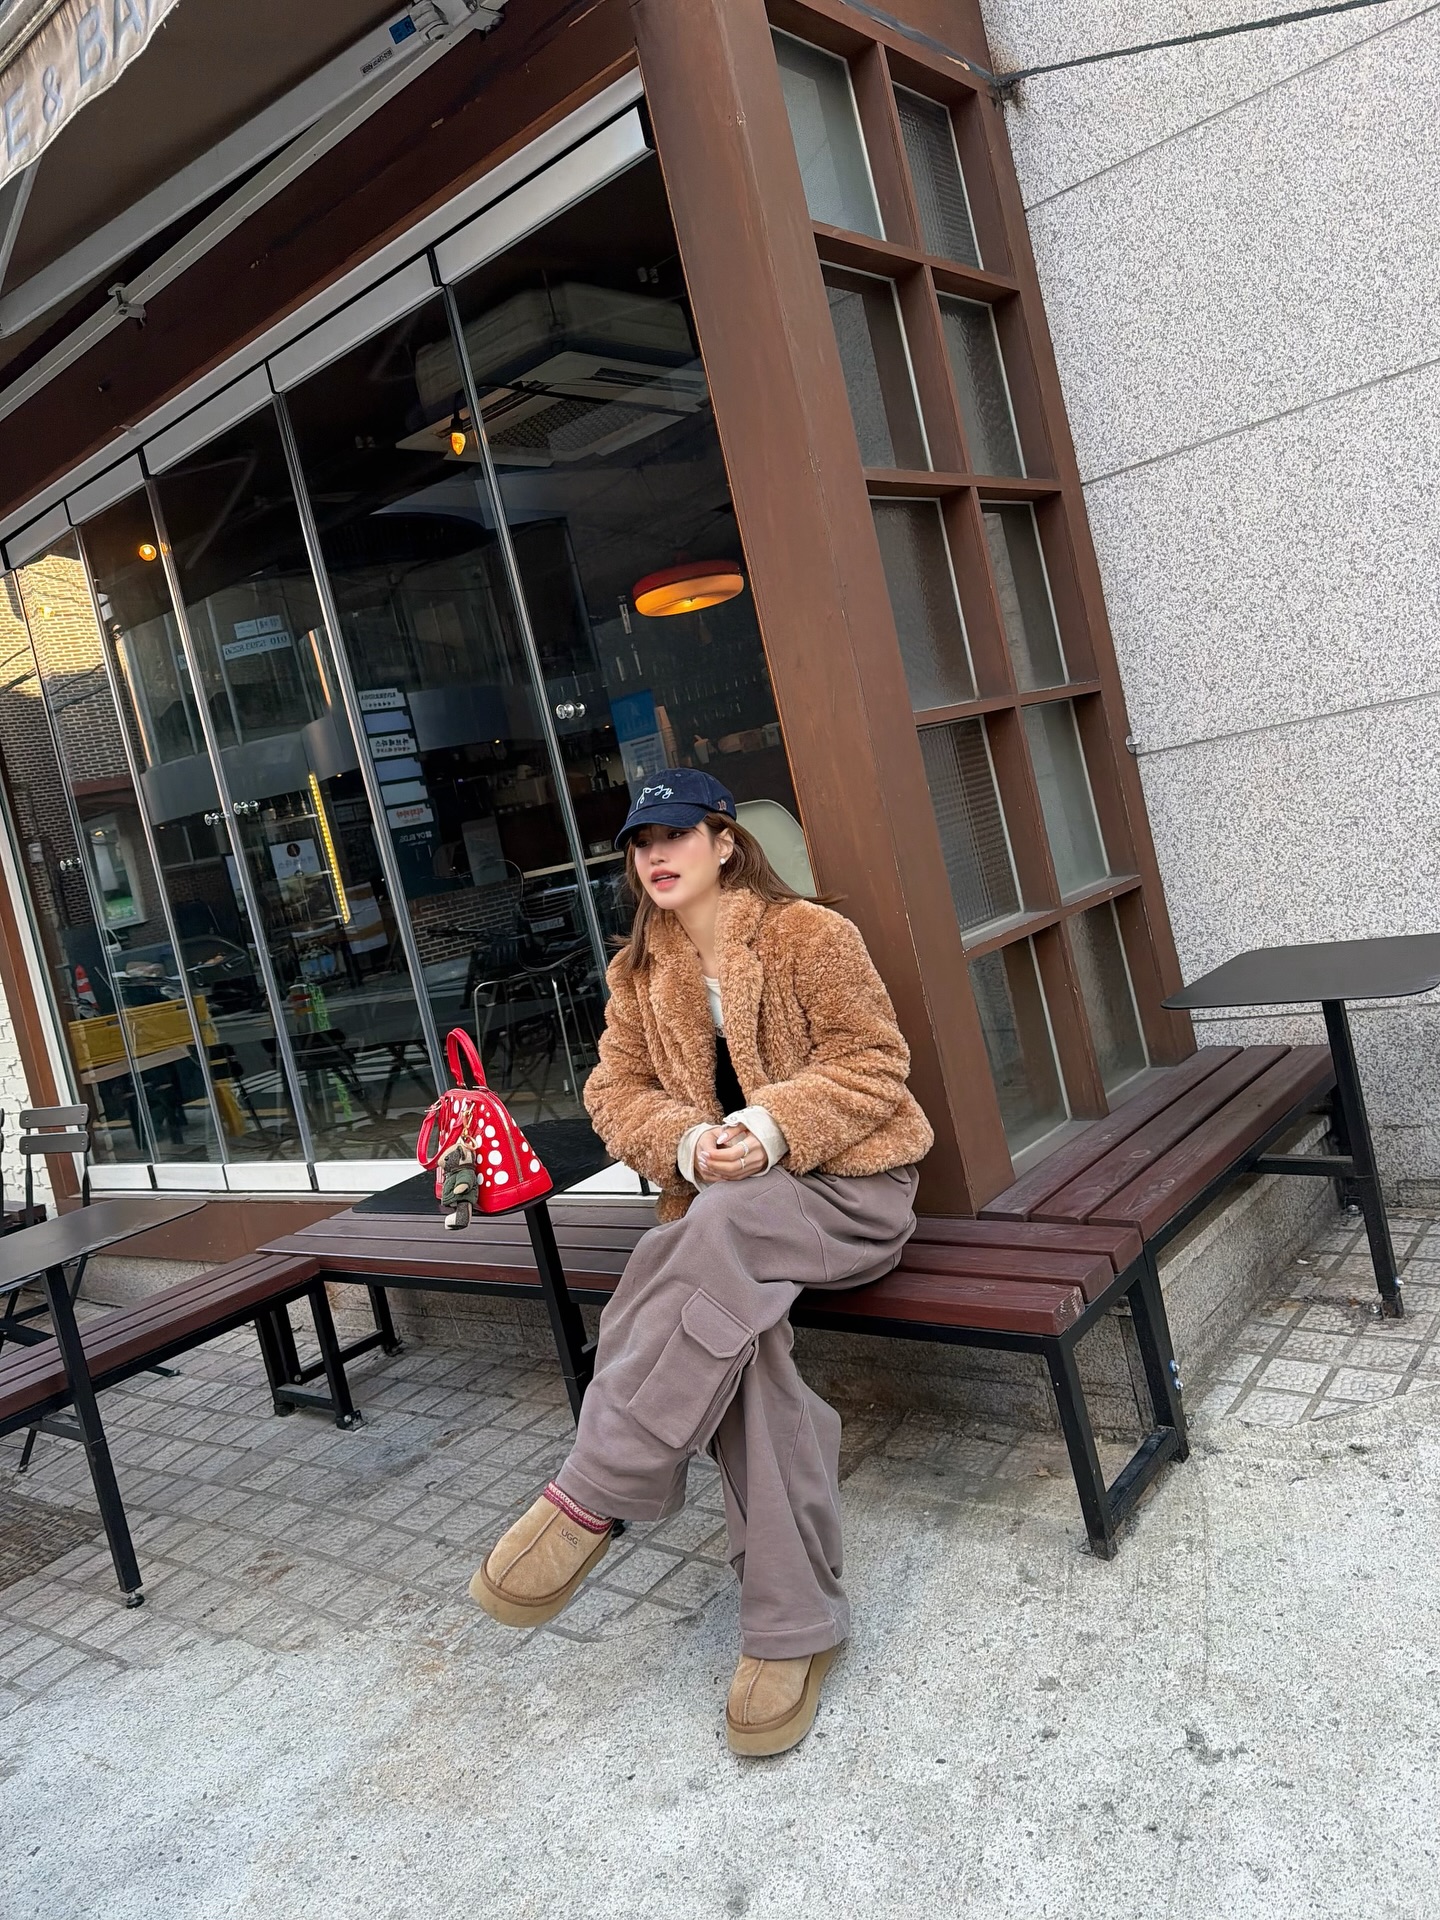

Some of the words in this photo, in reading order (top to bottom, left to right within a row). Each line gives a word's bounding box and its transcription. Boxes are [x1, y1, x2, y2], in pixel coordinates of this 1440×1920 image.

[4, 81, 31, 162] E
[42, 64, 64, 124] &
[77, 0, 152, 88] BA
[561, 1528, 578, 1545] UGG
